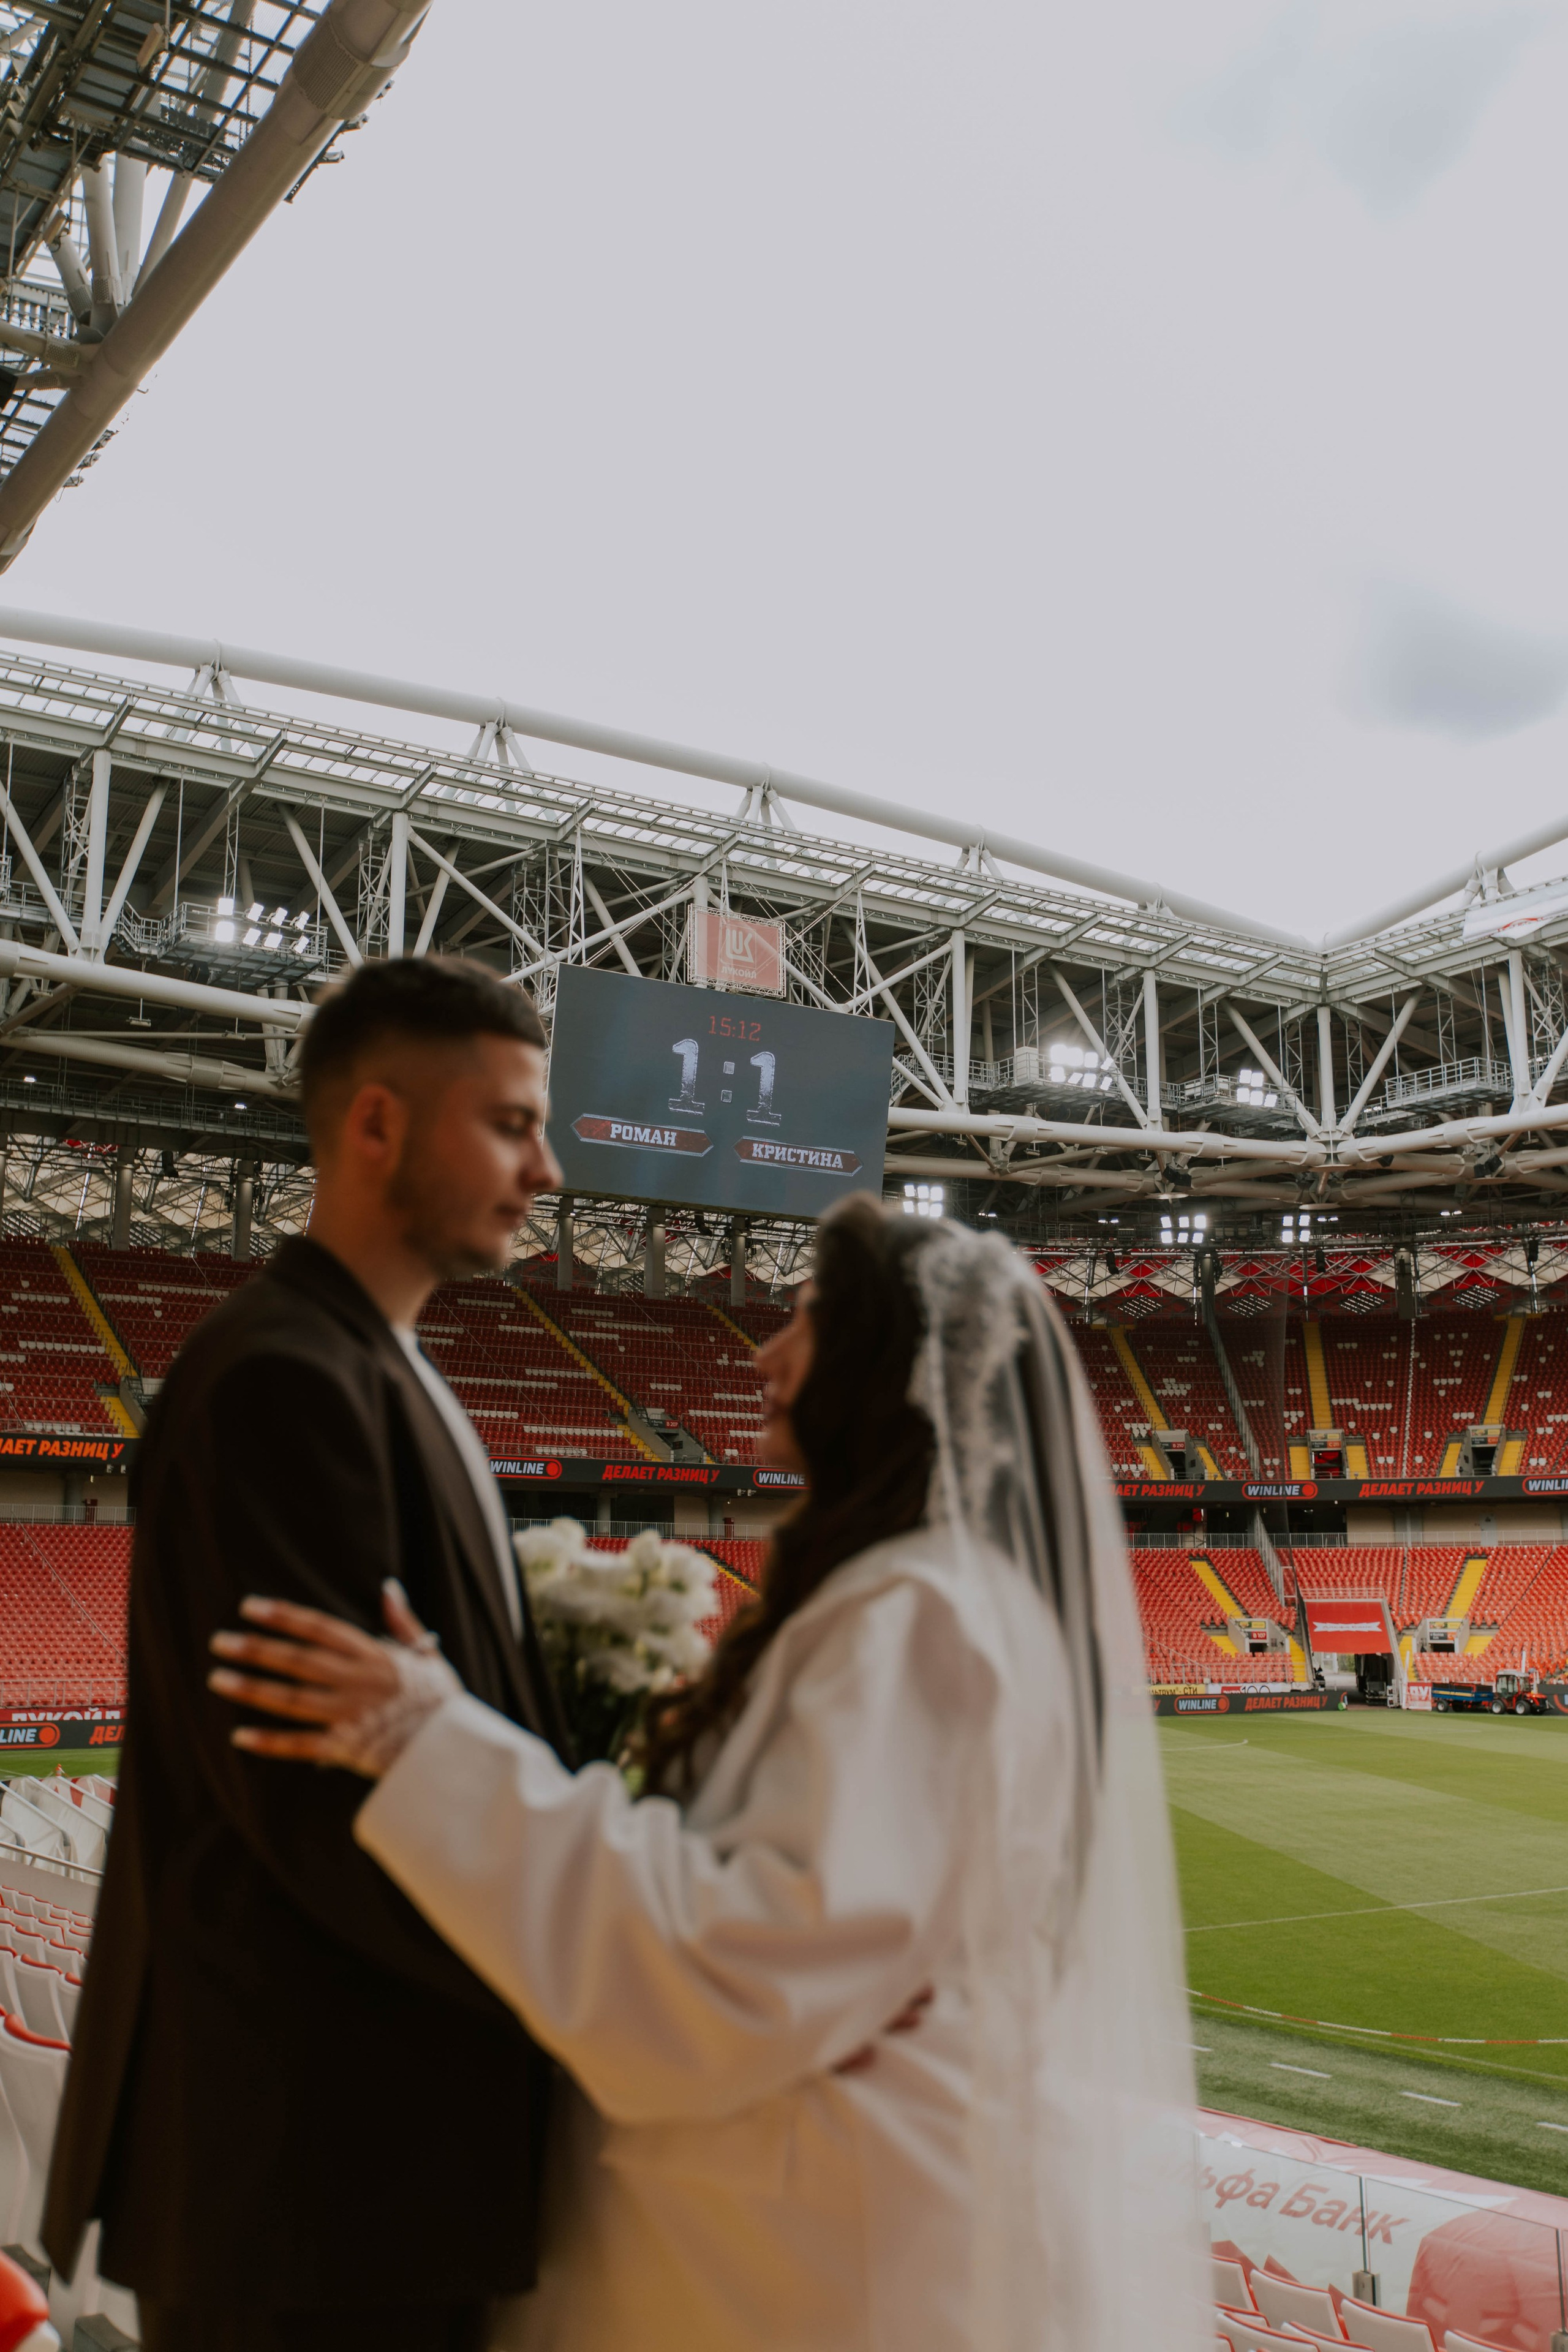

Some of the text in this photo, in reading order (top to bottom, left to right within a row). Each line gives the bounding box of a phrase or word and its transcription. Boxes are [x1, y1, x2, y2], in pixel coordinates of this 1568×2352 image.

[721, 966, 757, 979] ЛУКОЙЛ
[709, 1016, 762, 1041] 15:12
[610, 1123, 677, 1147] РОМАН
[752, 1143, 843, 1169] КРИСТИНА
[491, 1461, 544, 1474] WINLINE
[602, 1465, 655, 1480] ДЕЛАЕТ
[759, 1472, 805, 1485] WINLINE
[1248, 1485, 1300, 1496] WINLINE
[1359, 1483, 1414, 1498] ДЕЛАЕТ
[1178, 1699, 1216, 1710] WINLINE
[1245, 1697, 1283, 1711] ДЕЛАЕТ
[1278, 2182, 1411, 2245] Банк
